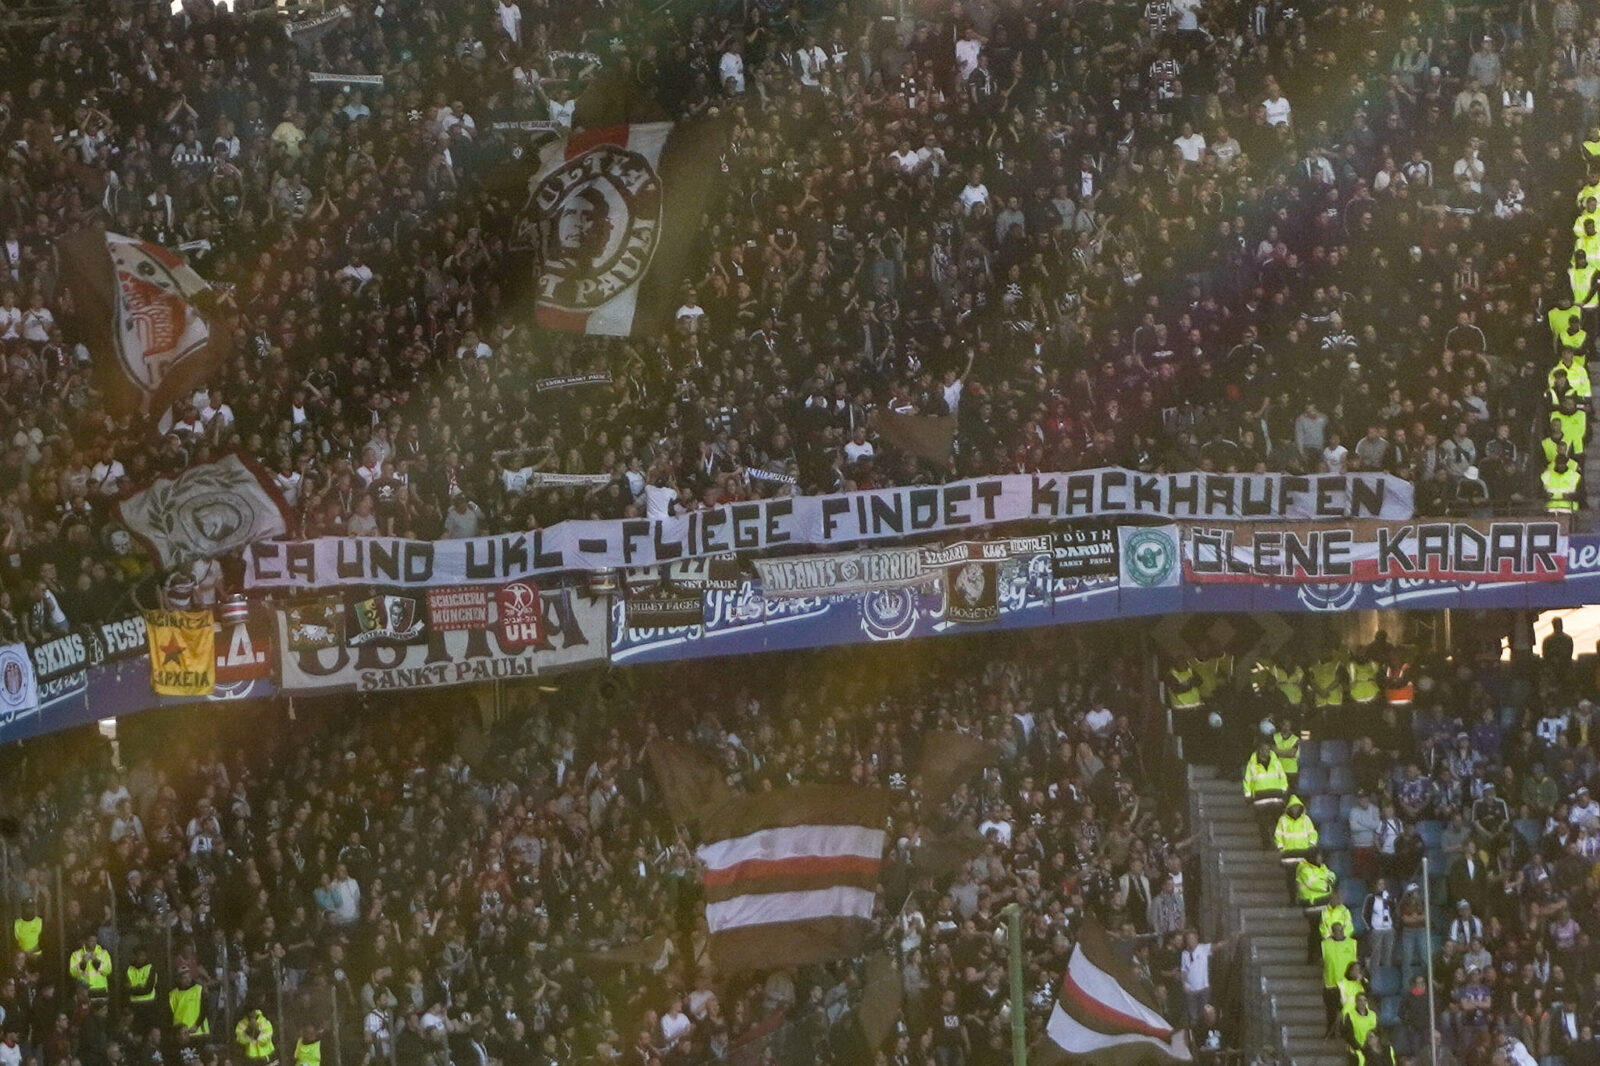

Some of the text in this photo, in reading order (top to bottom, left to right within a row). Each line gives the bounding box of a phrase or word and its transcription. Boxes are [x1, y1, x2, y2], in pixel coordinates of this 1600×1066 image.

[337, 539, 434, 582] UND
[465, 530, 563, 579] UKL
[622, 499, 793, 564] FLIEGE
[822, 482, 1002, 539] FINDET
[1031, 473, 1385, 518] KACKHAUFEN
[1376, 521, 1561, 574] KADAR
[764, 558, 835, 591] ENFANTS
[431, 592, 486, 608] SCHICKERIA
[102, 616, 147, 653] FCSP
[505, 623, 537, 642] UH
[34, 633, 87, 676] SKINS
[361, 657, 534, 690] SANKT PAULI
